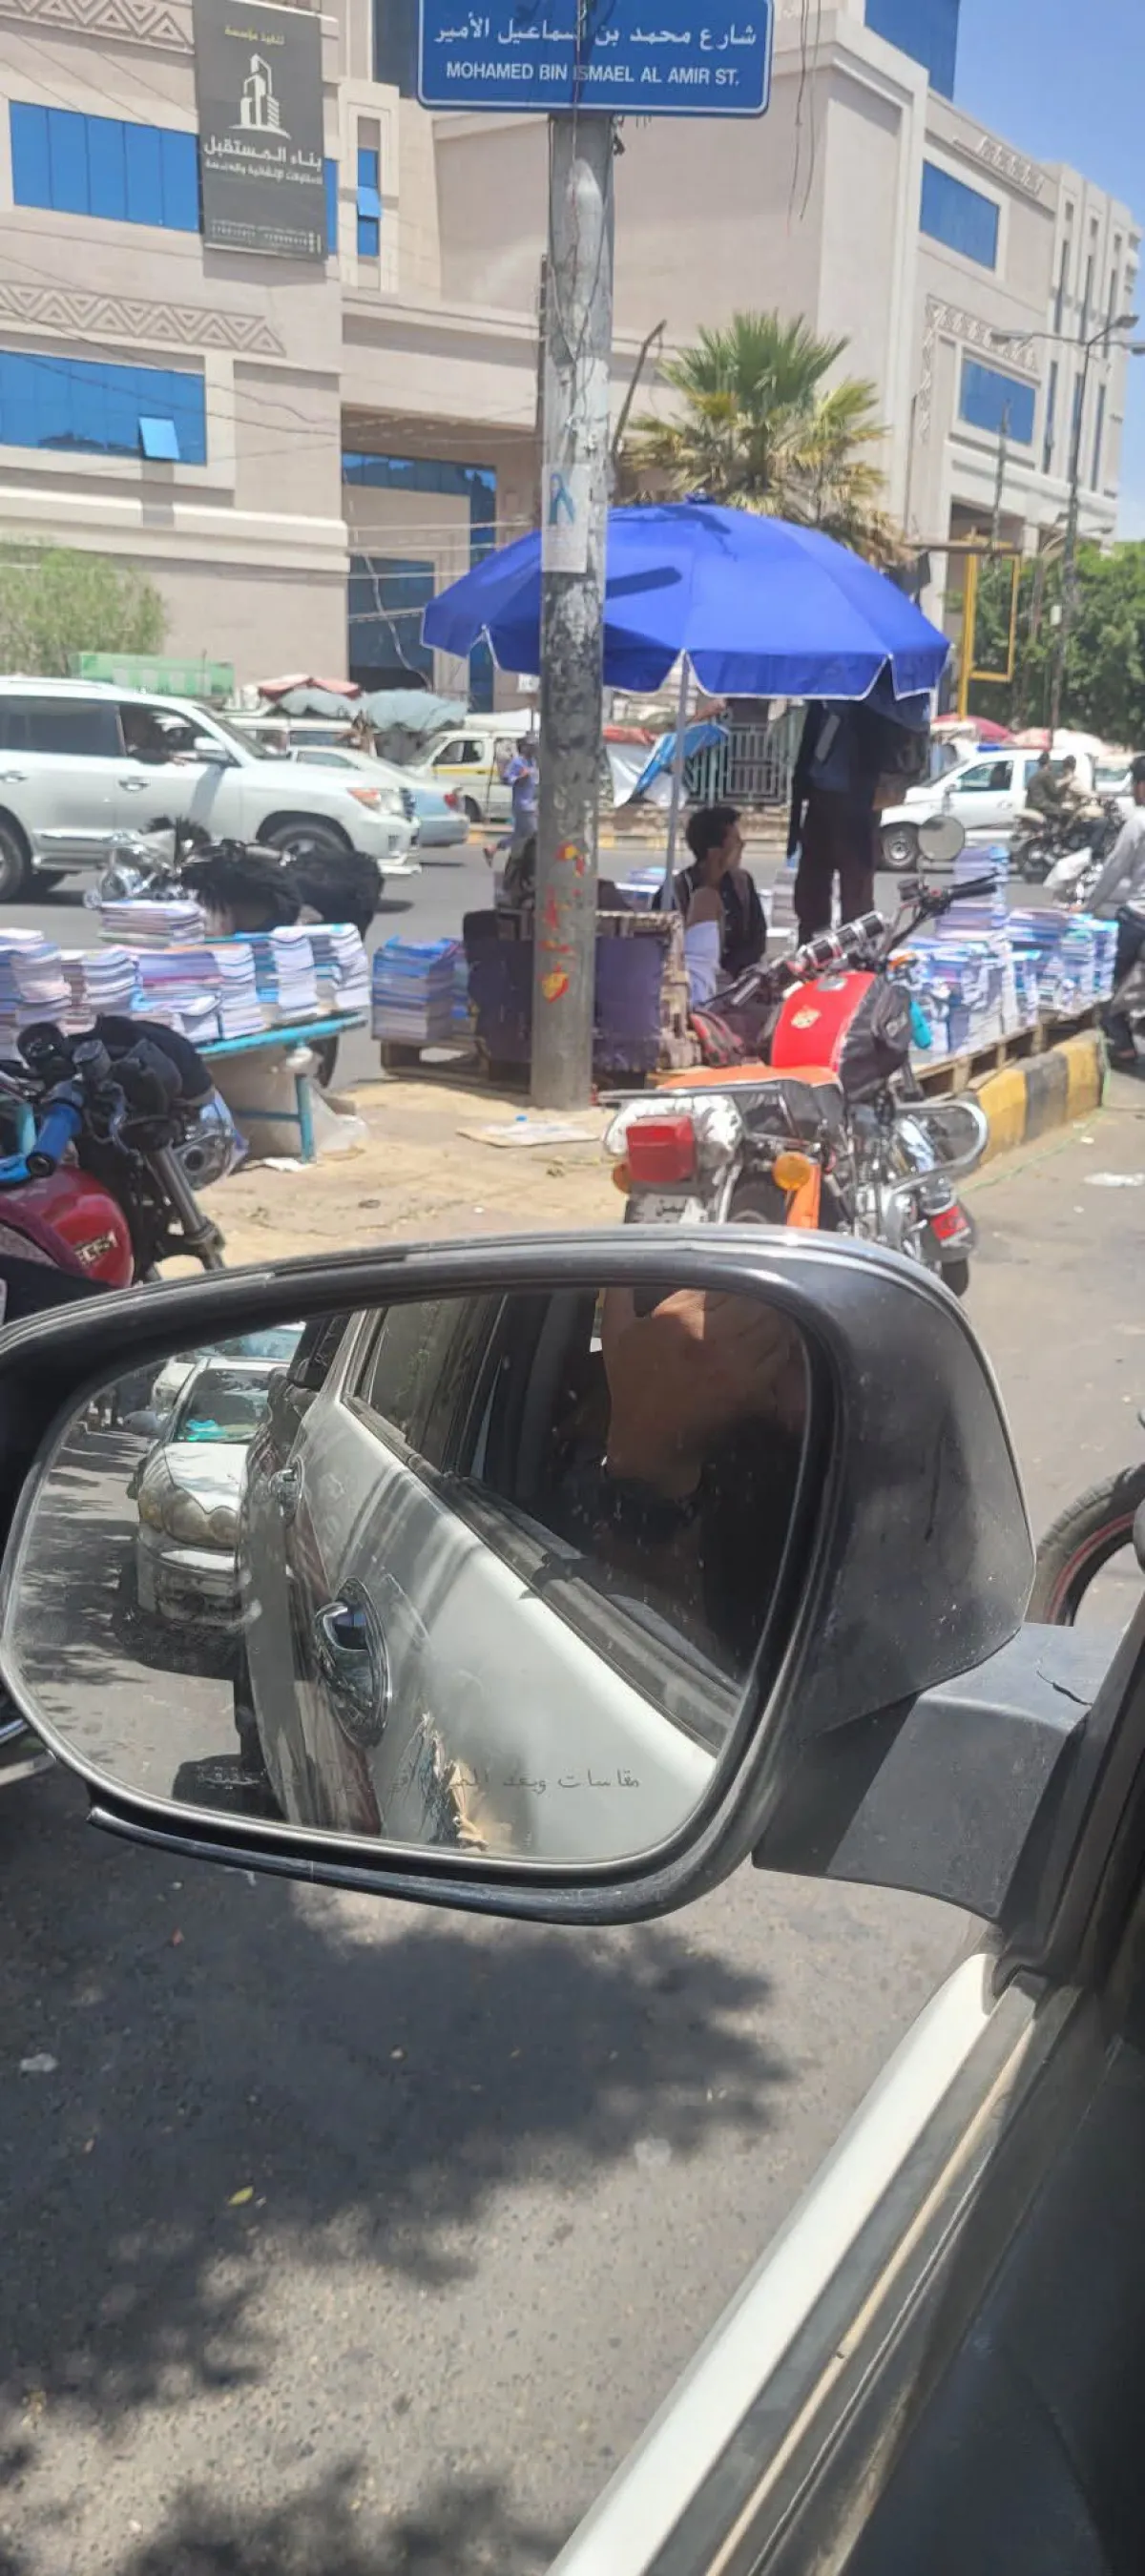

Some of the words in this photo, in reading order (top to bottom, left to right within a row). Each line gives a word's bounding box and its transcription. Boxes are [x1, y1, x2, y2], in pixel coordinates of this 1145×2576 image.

[434, 11, 490, 43] الأمير
[594, 26, 619, 48] بن
[630, 27, 691, 45] محمد
[699, 24, 757, 51] شارع
[447, 61, 534, 80] MOHAMED
[539, 63, 568, 81] BIN
[573, 63, 635, 83] ISMAEL
[640, 66, 661, 83] AL
[668, 67, 710, 85] AMIR
[716, 68, 739, 86] ST.
[203, 134, 287, 164] المستقبل
[290, 149, 323, 173] بناء
[557, 1768, 641, 1788] مقاسات
